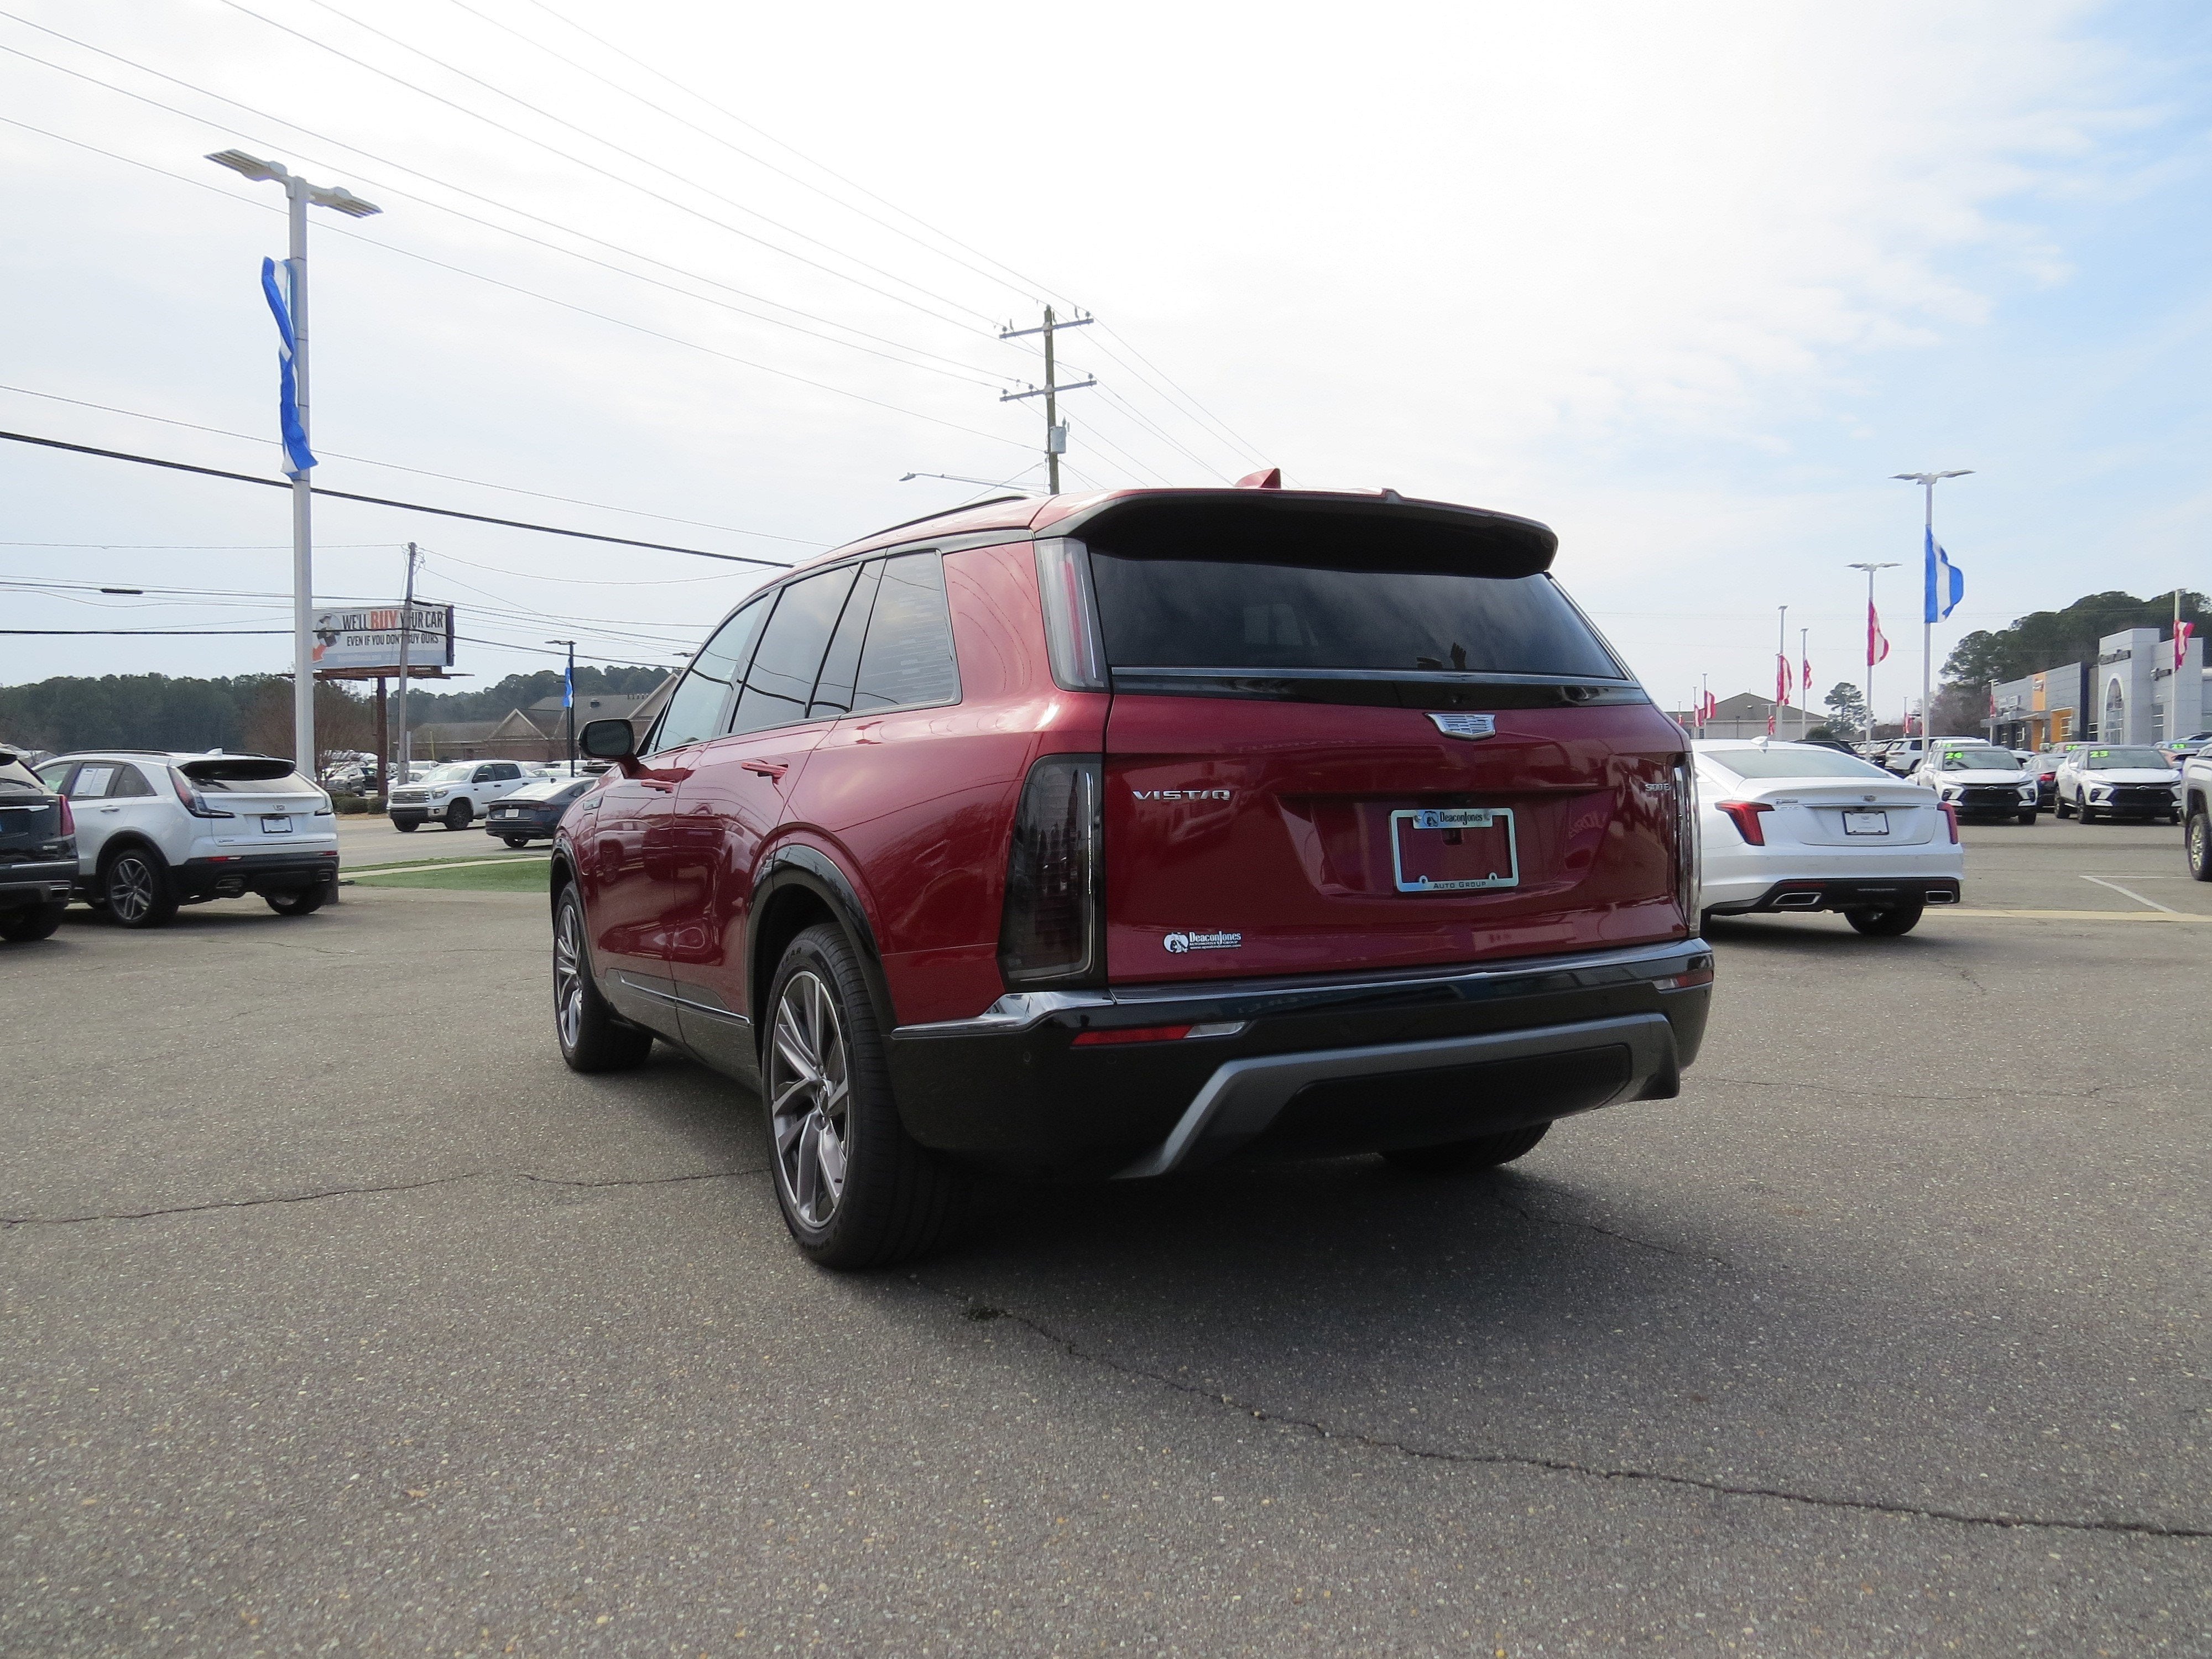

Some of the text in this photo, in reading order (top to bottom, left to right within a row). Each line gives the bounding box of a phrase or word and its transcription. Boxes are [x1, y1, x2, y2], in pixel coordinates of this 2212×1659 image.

[371, 610, 397, 630] BUY
[425, 611, 444, 628] CAR
[346, 635, 363, 646] EVEN
[364, 635, 371, 645] IF
[372, 634, 385, 645] YOU
[421, 633, 439, 644] OURS
